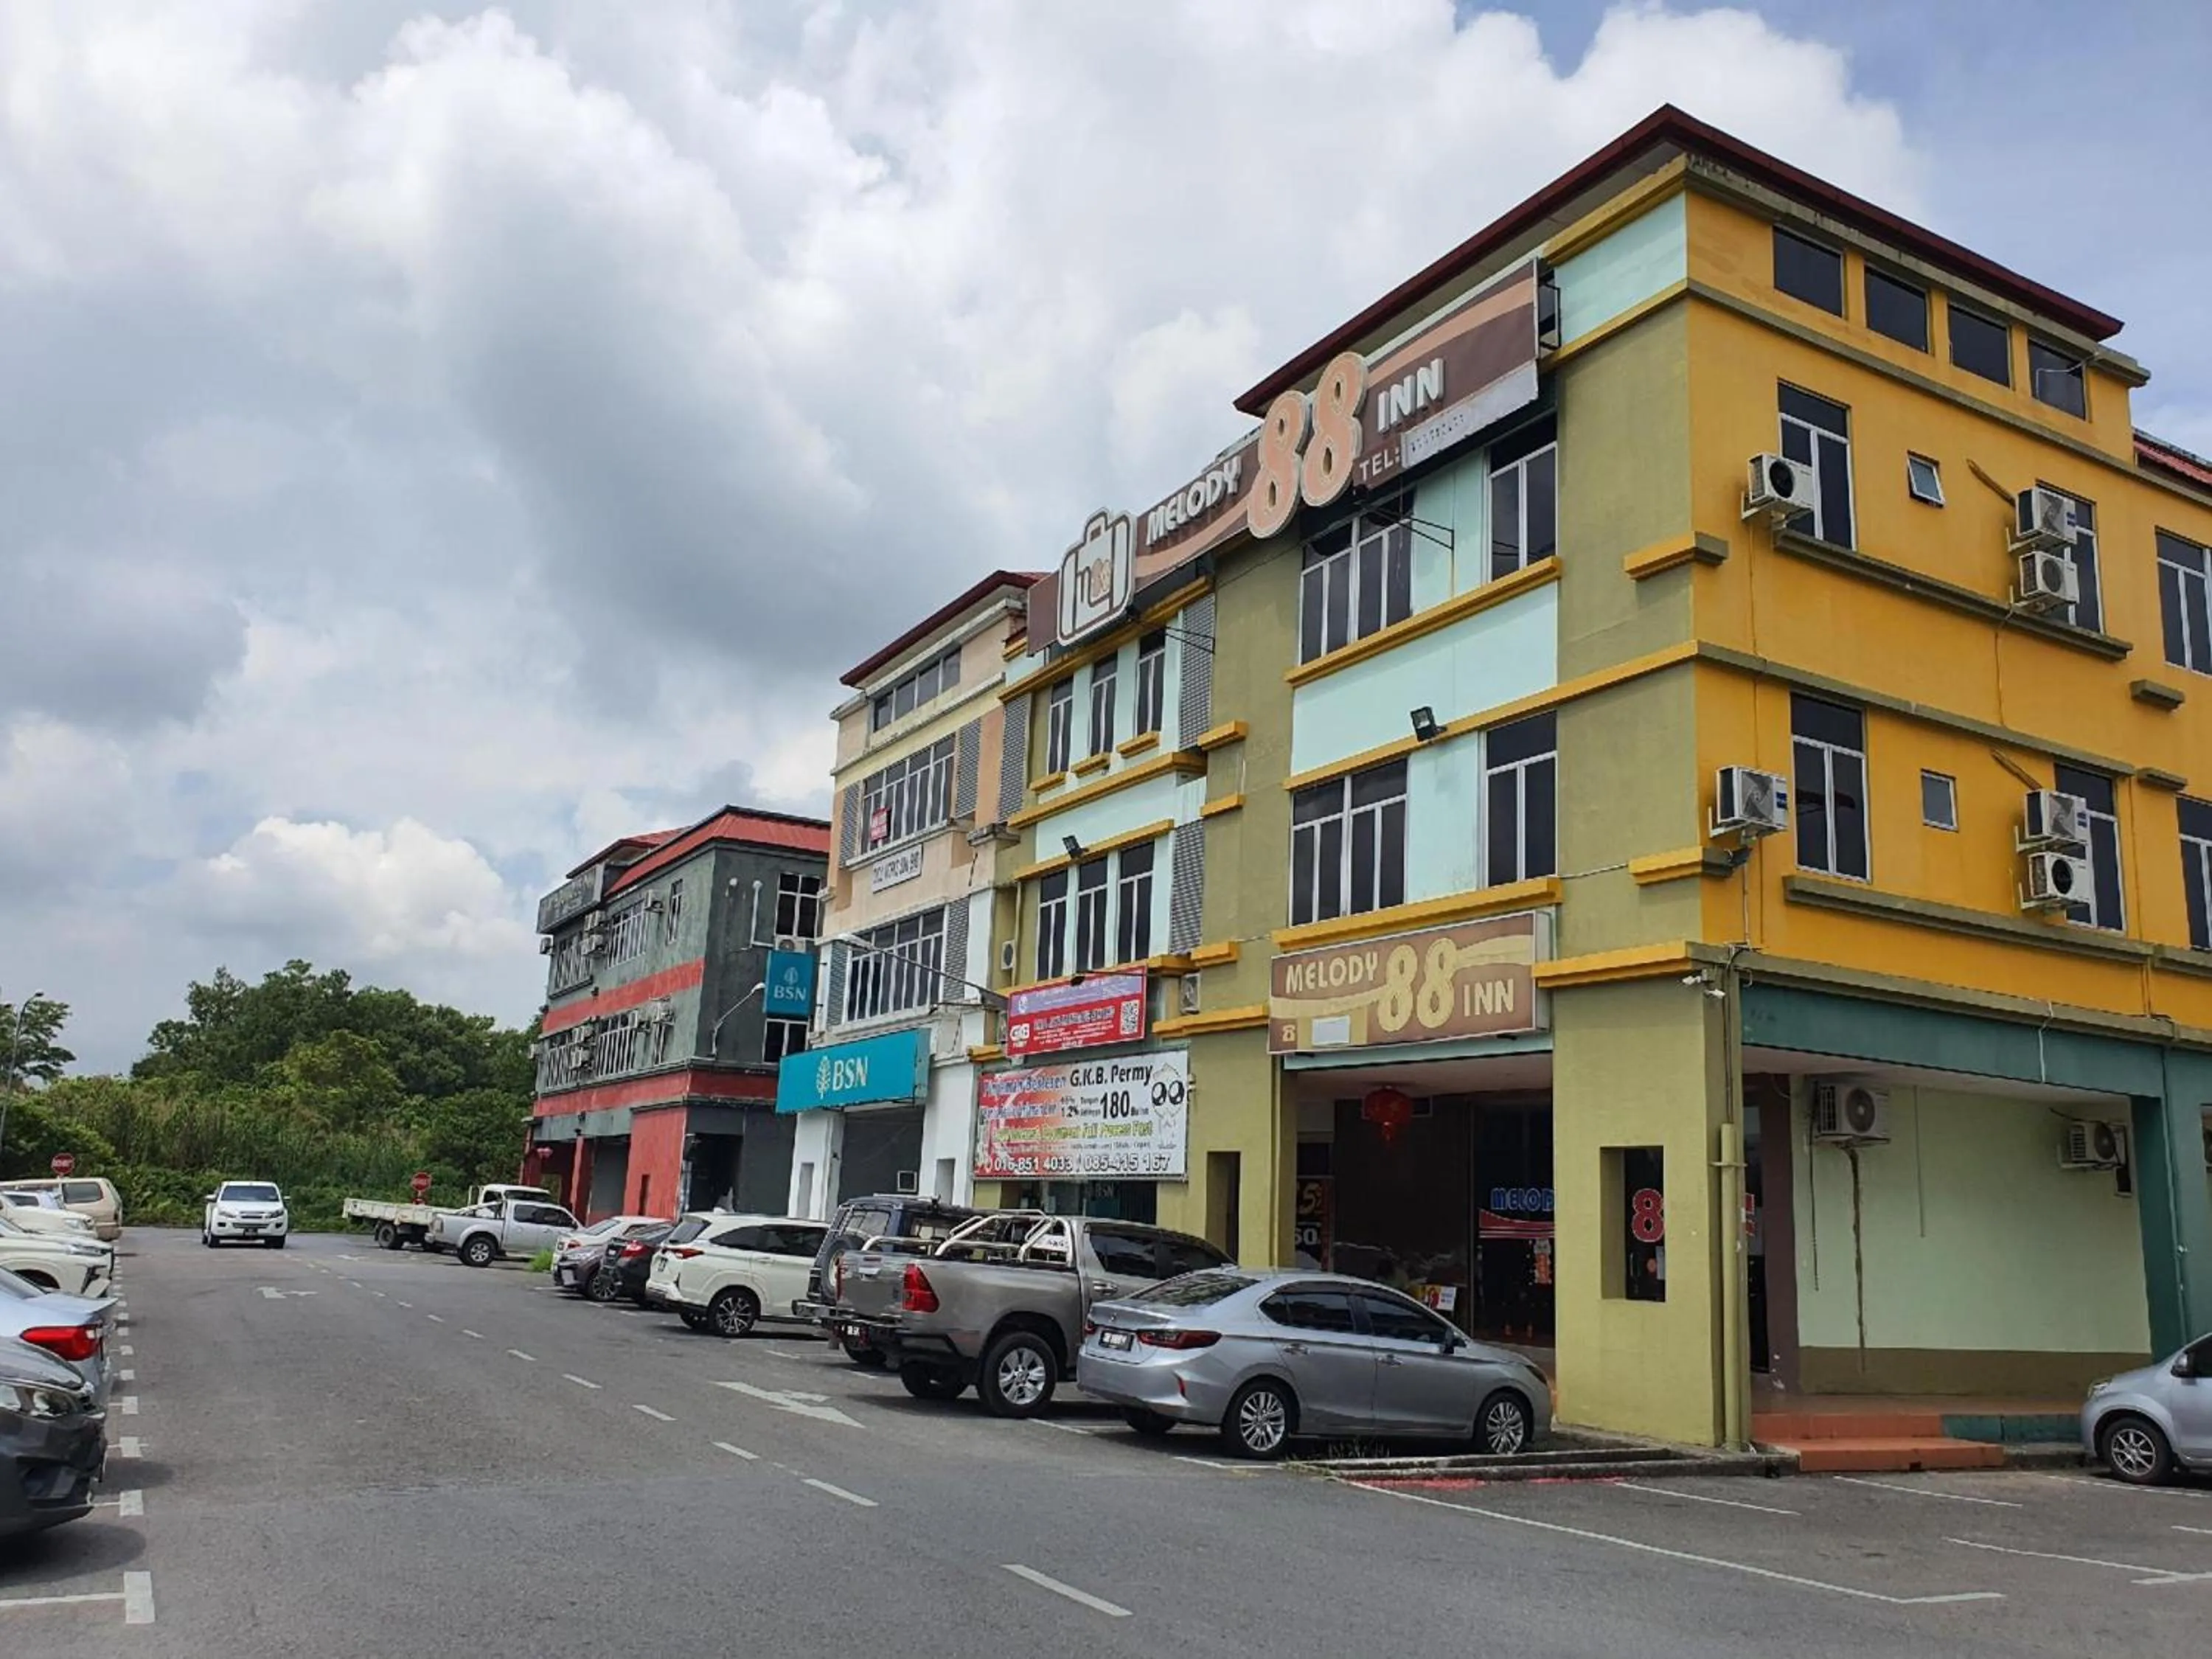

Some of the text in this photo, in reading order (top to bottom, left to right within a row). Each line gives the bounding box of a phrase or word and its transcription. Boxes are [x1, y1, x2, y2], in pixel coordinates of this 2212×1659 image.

[1146, 455, 1242, 546] MELODY
[1247, 351, 1368, 539] 88
[1377, 358, 1445, 434] INN
[1359, 447, 1400, 481] TEL:
[774, 984, 807, 1002] BSN
[1285, 937, 1515, 1032] MELODY 88 INN
[832, 1055, 869, 1092] BSN
[1070, 1066, 1108, 1088] G.K.B.
[1111, 1064, 1154, 1086] Permy
[1100, 1090, 1130, 1119] 180
